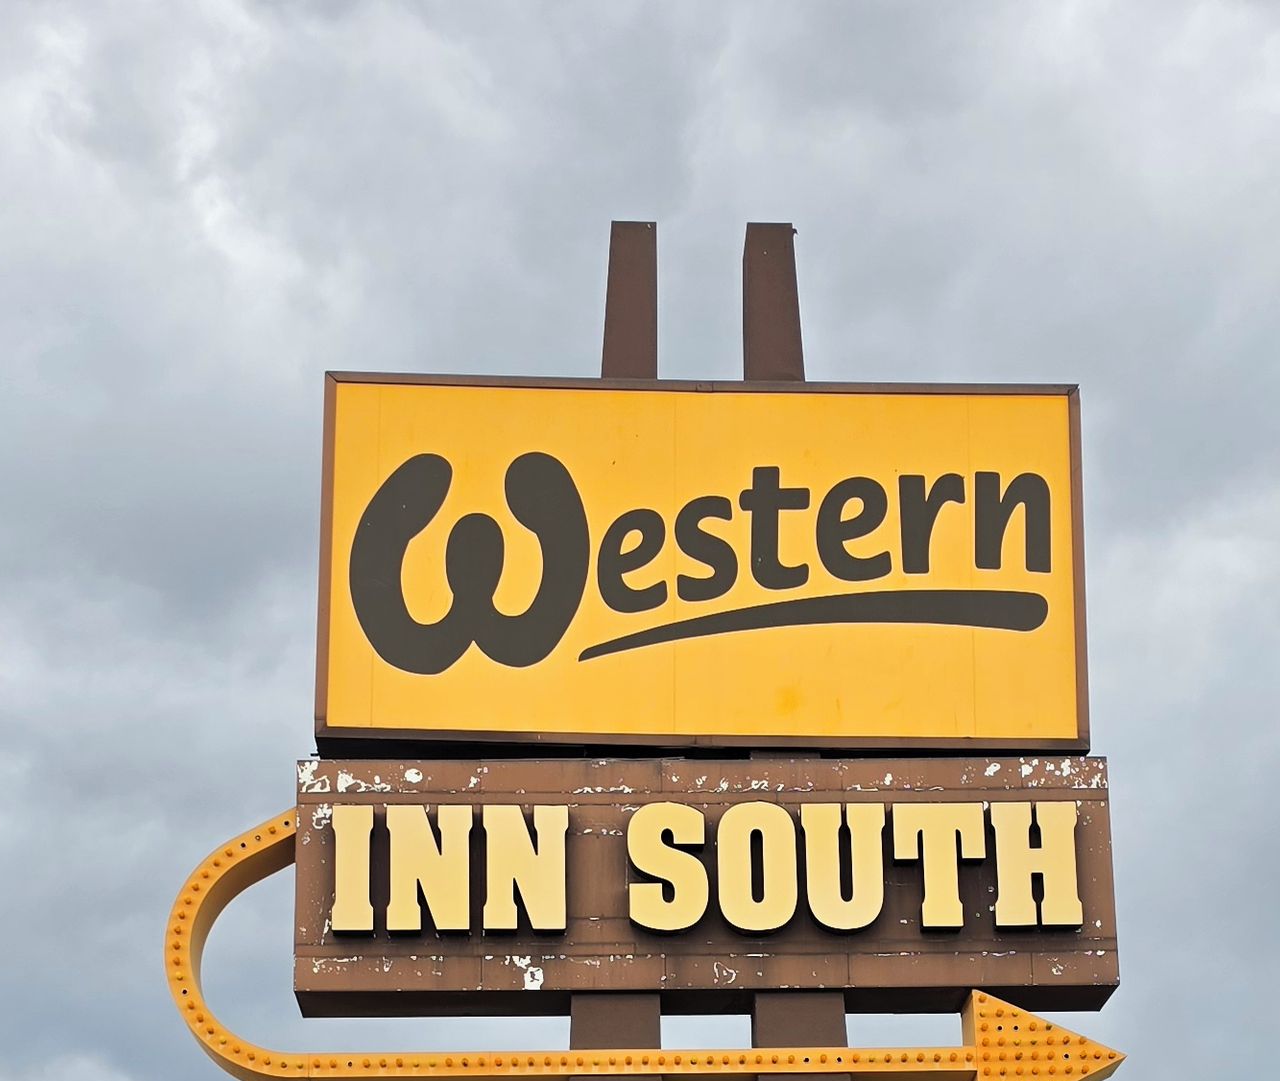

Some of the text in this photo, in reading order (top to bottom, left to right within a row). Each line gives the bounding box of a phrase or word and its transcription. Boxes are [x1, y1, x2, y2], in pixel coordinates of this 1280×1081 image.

[349, 451, 1052, 675] Western
[331, 801, 1084, 933] INN SOUTH
